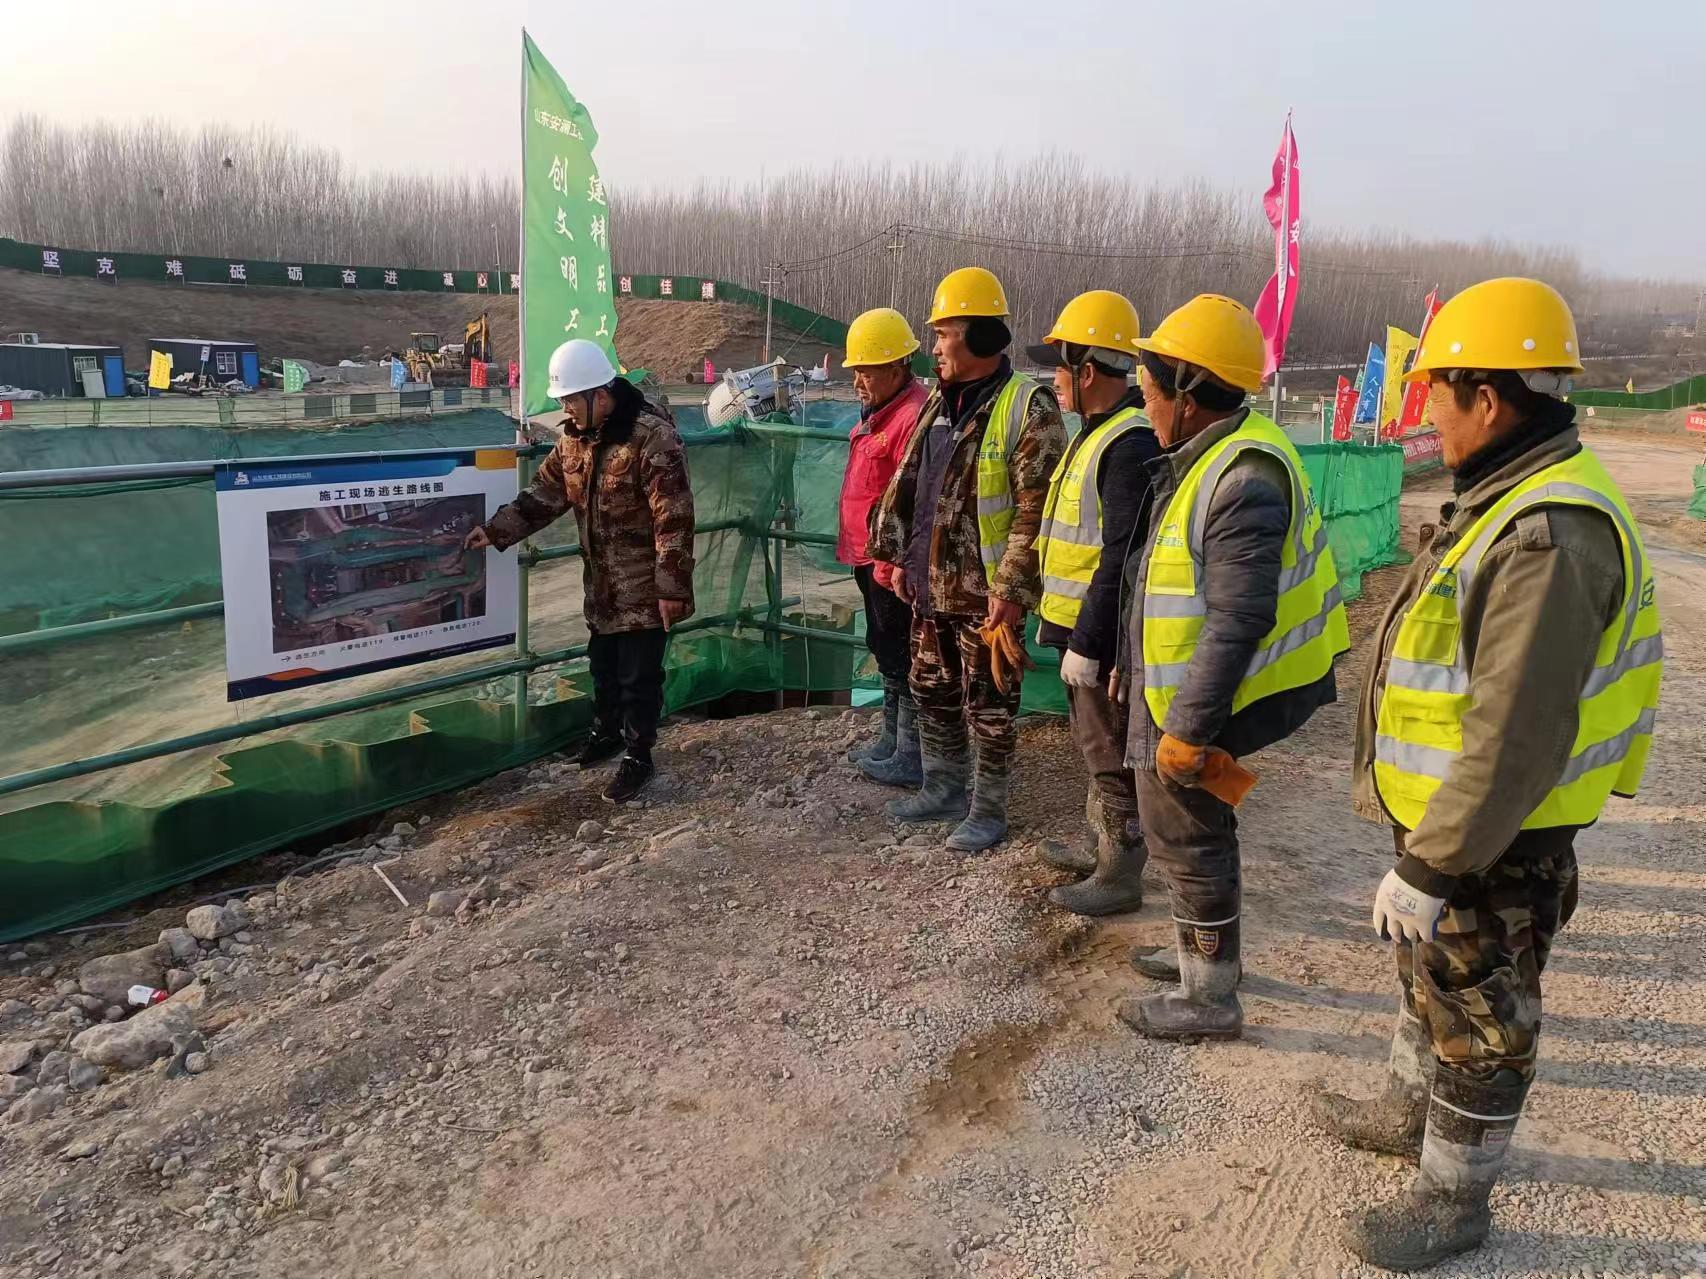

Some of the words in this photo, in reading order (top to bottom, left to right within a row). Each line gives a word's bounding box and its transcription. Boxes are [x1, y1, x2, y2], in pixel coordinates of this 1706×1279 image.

[548, 154, 580, 333] 创文明工
[319, 481, 445, 502] 施工现场逃生路线图
